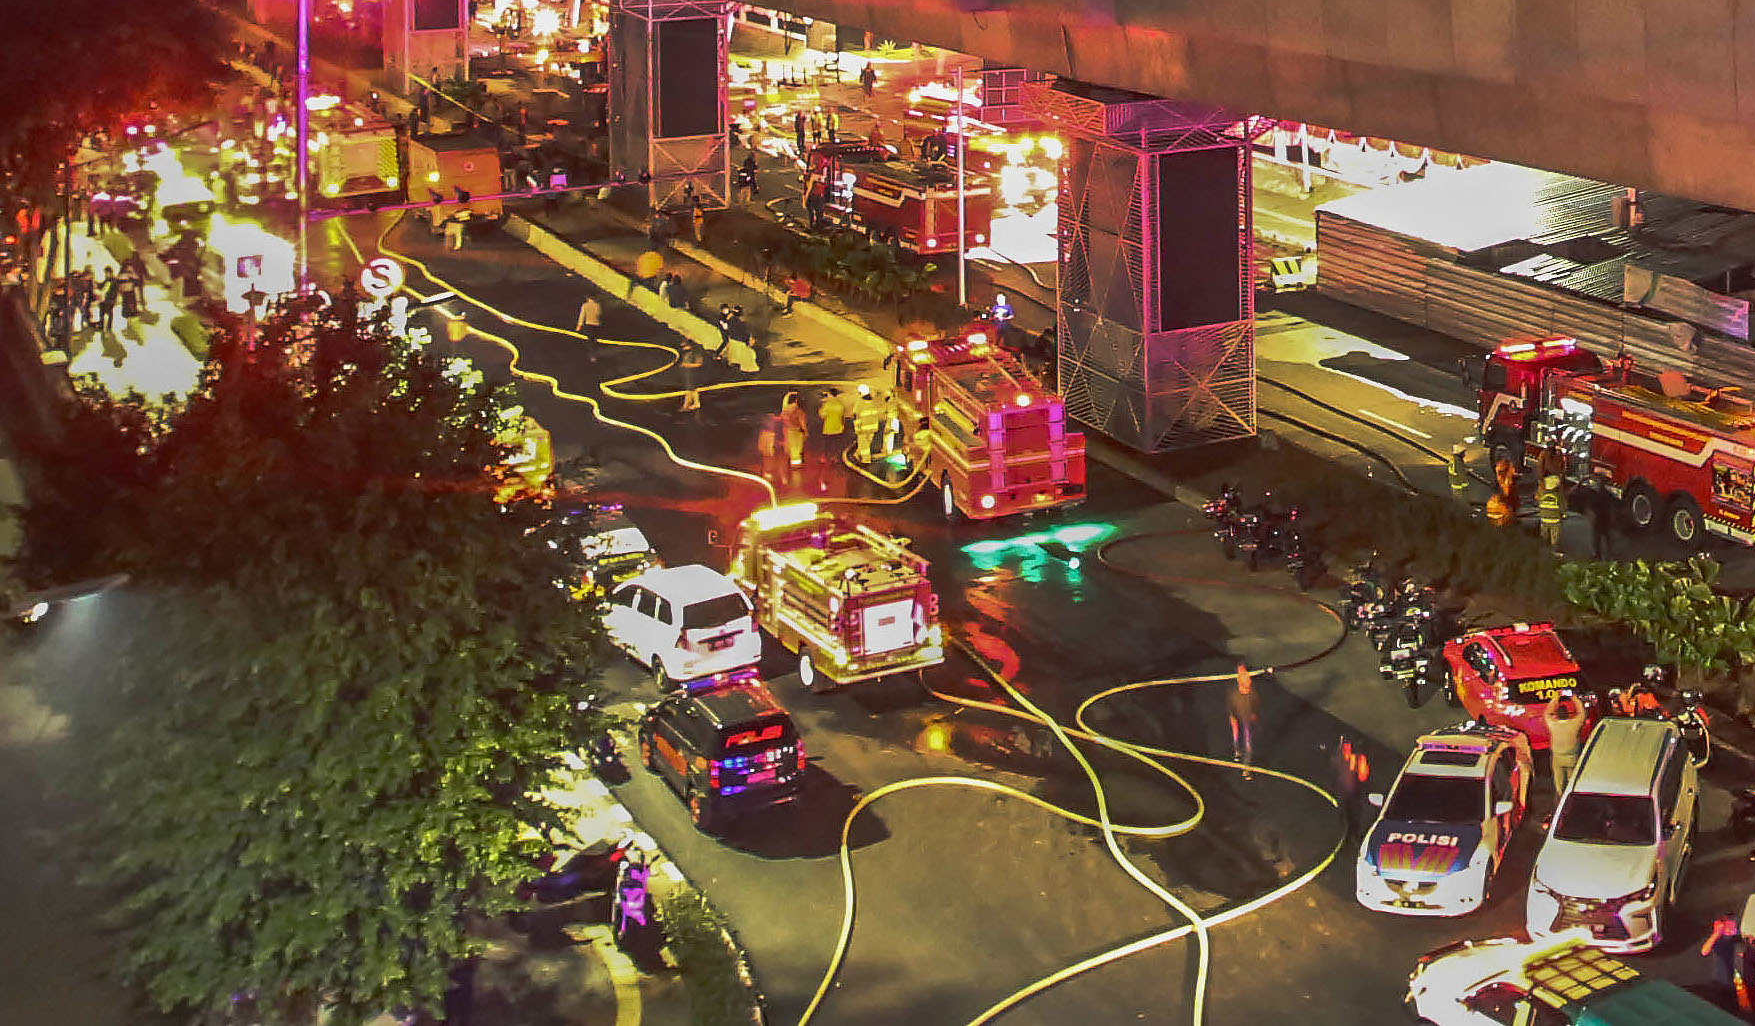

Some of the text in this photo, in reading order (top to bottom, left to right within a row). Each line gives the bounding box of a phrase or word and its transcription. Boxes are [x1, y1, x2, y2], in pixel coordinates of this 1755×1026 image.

[370, 264, 391, 290] S
[1518, 677, 1578, 694] KOMANDO
[1387, 832, 1460, 847] POLISI
